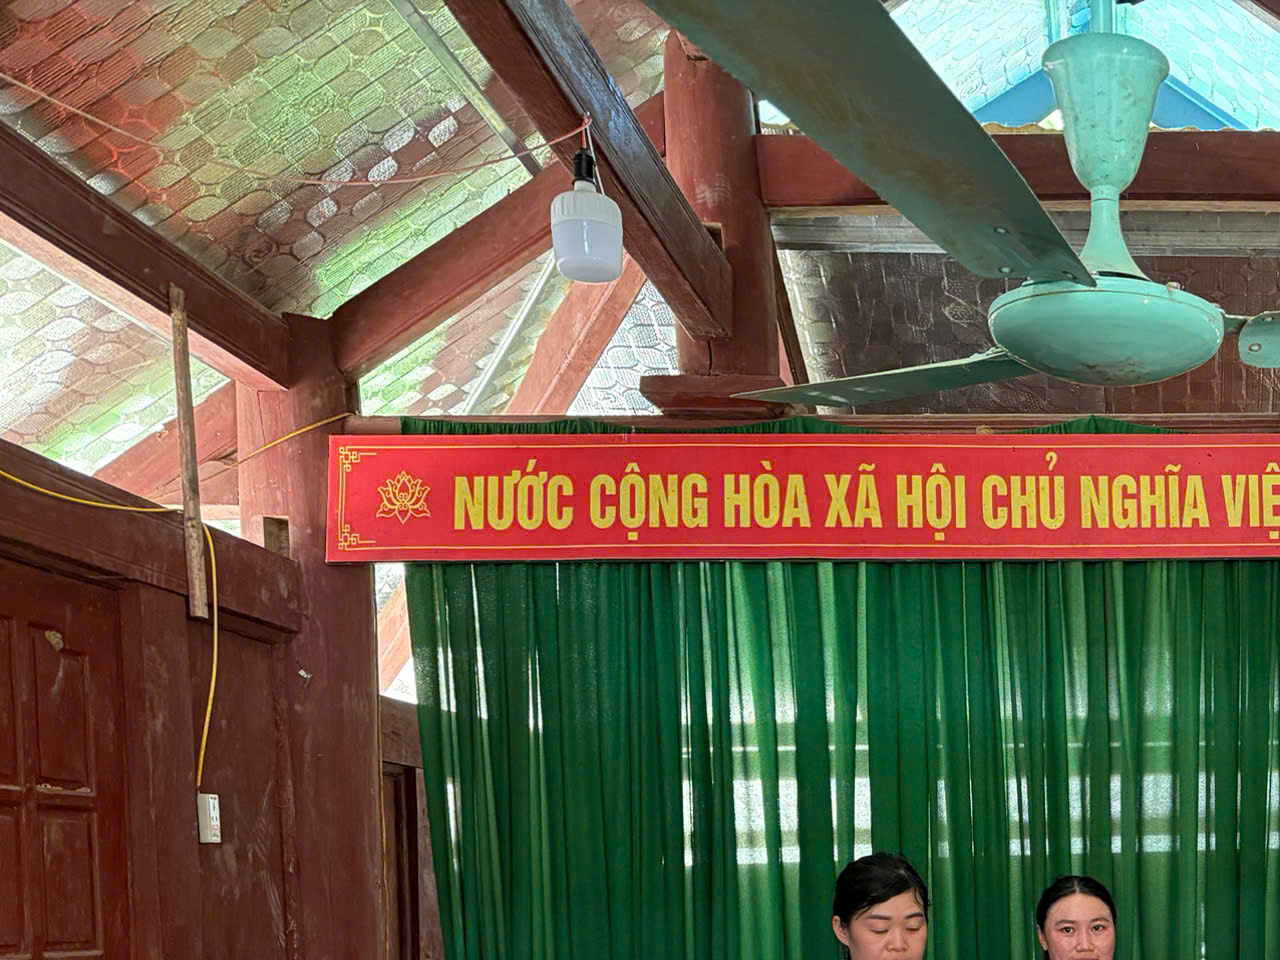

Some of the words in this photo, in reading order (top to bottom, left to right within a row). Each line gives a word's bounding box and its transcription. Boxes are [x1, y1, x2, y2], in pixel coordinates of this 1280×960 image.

[455, 459, 574, 530] NƯỚC
[590, 463, 708, 541] CỘNG
[724, 460, 811, 529] HÒA
[824, 463, 883, 528] XÃ
[897, 463, 967, 541] HỘI
[982, 451, 1065, 530] CHỦ
[1080, 463, 1210, 529] NGHĨA
